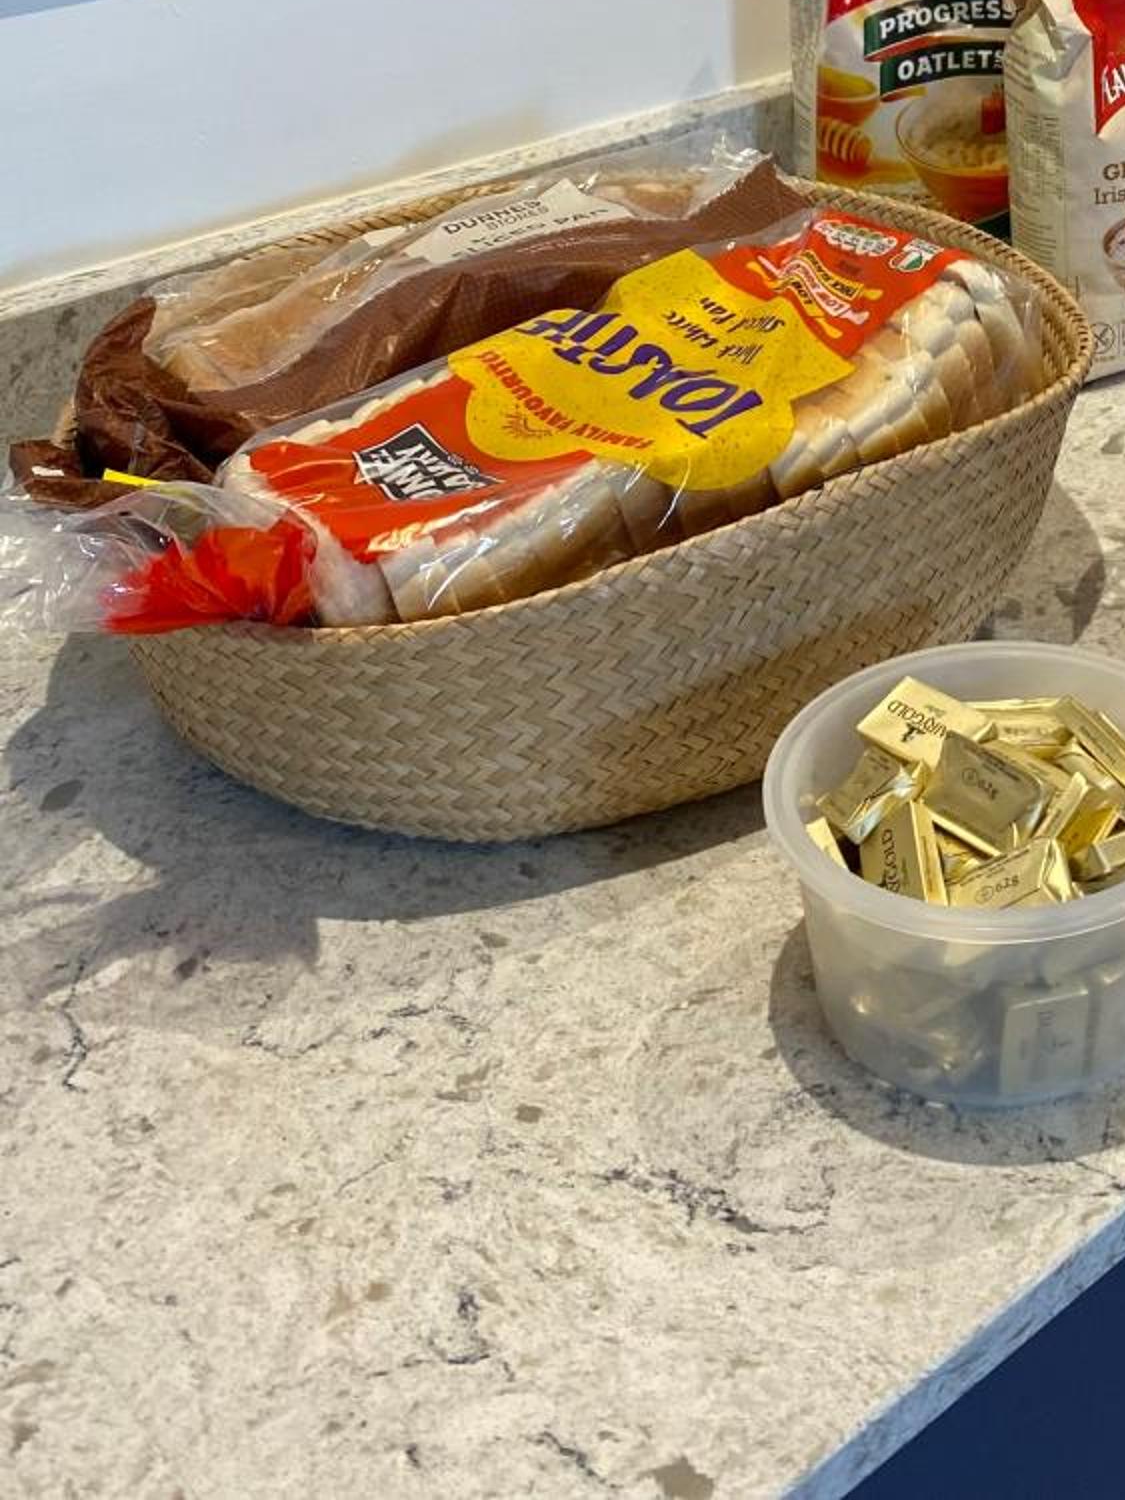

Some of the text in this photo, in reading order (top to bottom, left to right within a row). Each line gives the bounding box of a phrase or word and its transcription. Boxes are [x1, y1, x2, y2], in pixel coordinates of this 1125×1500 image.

[879, 0, 1016, 39] PROGRESS
[442, 200, 541, 235] DUNNES
[699, 297, 785, 333] Sliced Pan
[661, 311, 763, 365] Thick White
[571, 423, 654, 449] FAMILY
